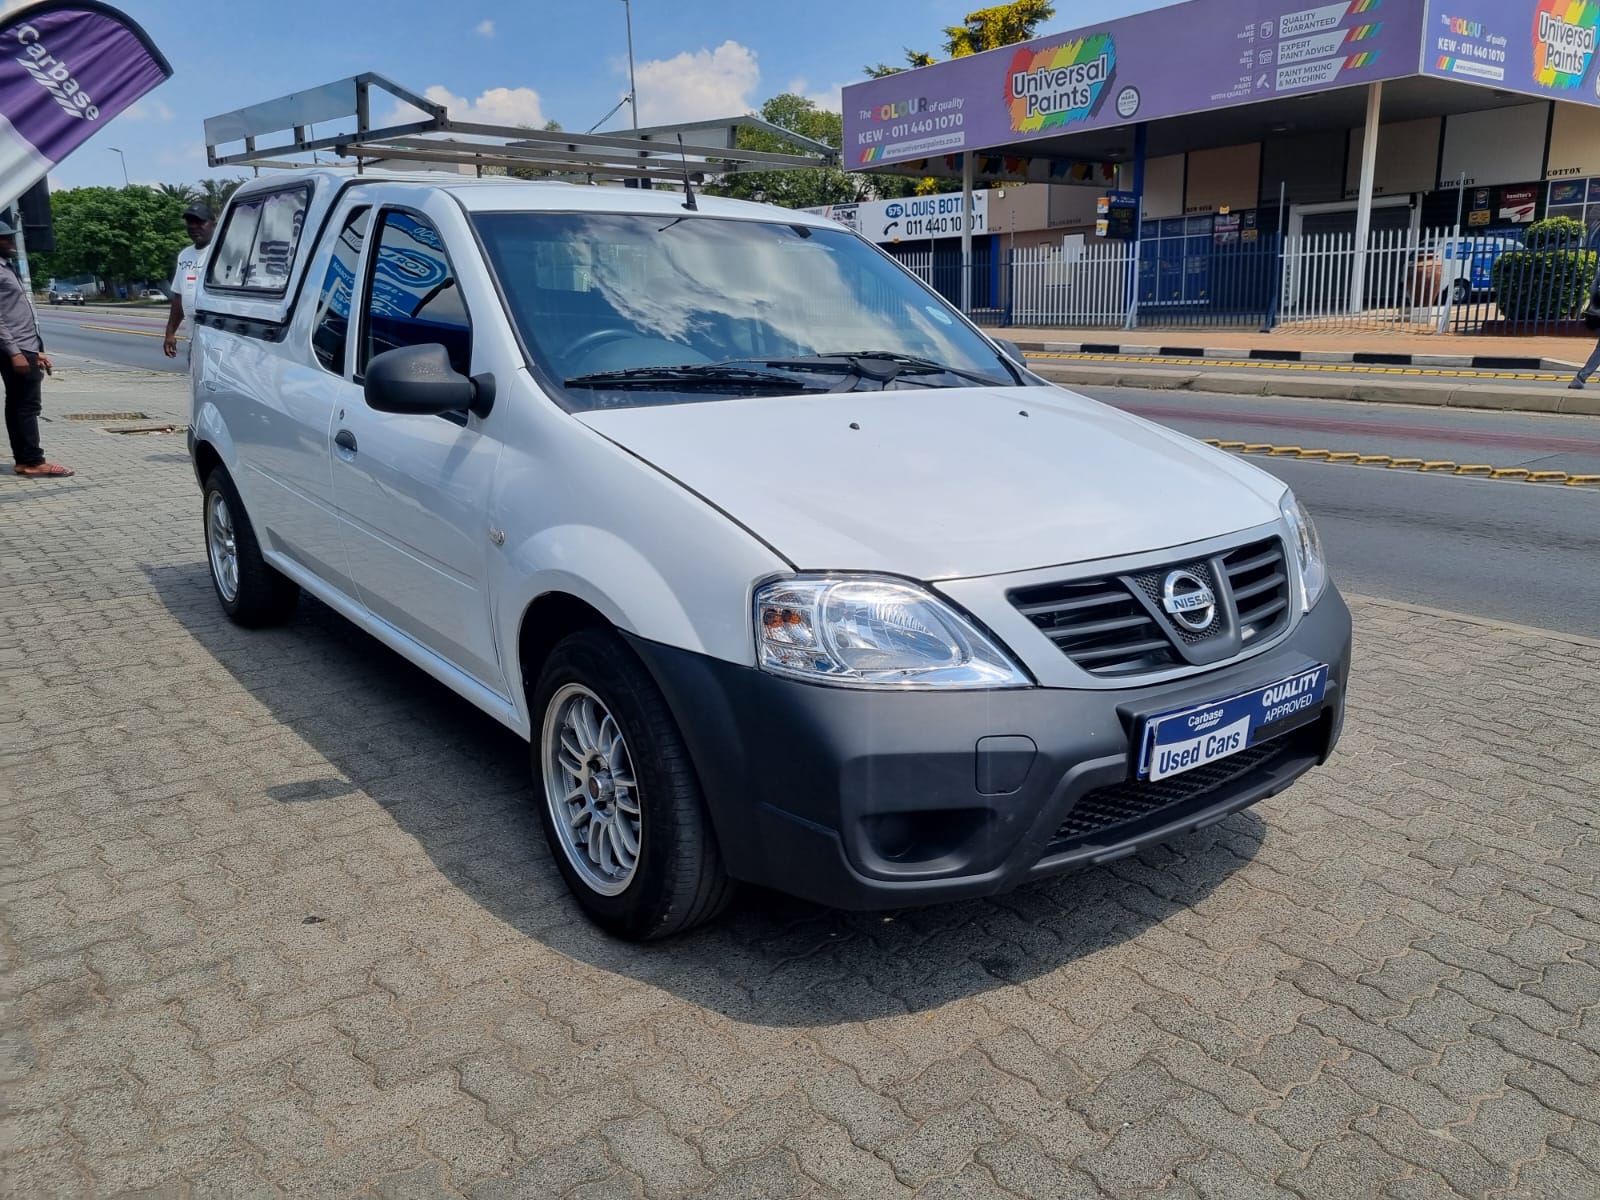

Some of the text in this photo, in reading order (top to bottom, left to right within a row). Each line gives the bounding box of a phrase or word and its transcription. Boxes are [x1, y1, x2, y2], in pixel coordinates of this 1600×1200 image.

[1281, 17, 1337, 34] GUARANTEED
[1282, 12, 1316, 26] QUALITY
[1441, 14, 1450, 26] The
[1450, 16, 1487, 39] COLOUR
[1539, 13, 1596, 52] Universal
[1280, 40, 1311, 53] EXPERT
[1280, 44, 1335, 60] PAINT ADVICE
[1438, 37, 1457, 52] KEW
[1461, 42, 1473, 56] 011
[1473, 46, 1488, 59] 440
[1488, 48, 1505, 63] 1070
[1545, 42, 1583, 73] Paints
[17, 25, 100, 121] Carbase
[1012, 56, 1106, 97] Universal
[1279, 62, 1333, 79] PAINT MIXING
[1285, 73, 1327, 85] MATCHING
[859, 97, 965, 123] The COLOUR of quality
[1027, 86, 1089, 115] Paints
[858, 128, 884, 145] KEW
[891, 123, 908, 138] 011
[911, 119, 933, 134] 440
[935, 113, 963, 130] 1070
[1547, 167, 1582, 177] COTTON
[888, 206, 901, 216] 575
[904, 199, 936, 218] LOUIS
[906, 219, 922, 236] 011
[925, 217, 948, 233] 440
[1173, 592, 1214, 610] NISSAN
[1262, 670, 1320, 707] QUALITY
[1188, 708, 1224, 728] Carbase
[1263, 693, 1313, 724] APPROVED
[1159, 729, 1241, 775] Used Cars
